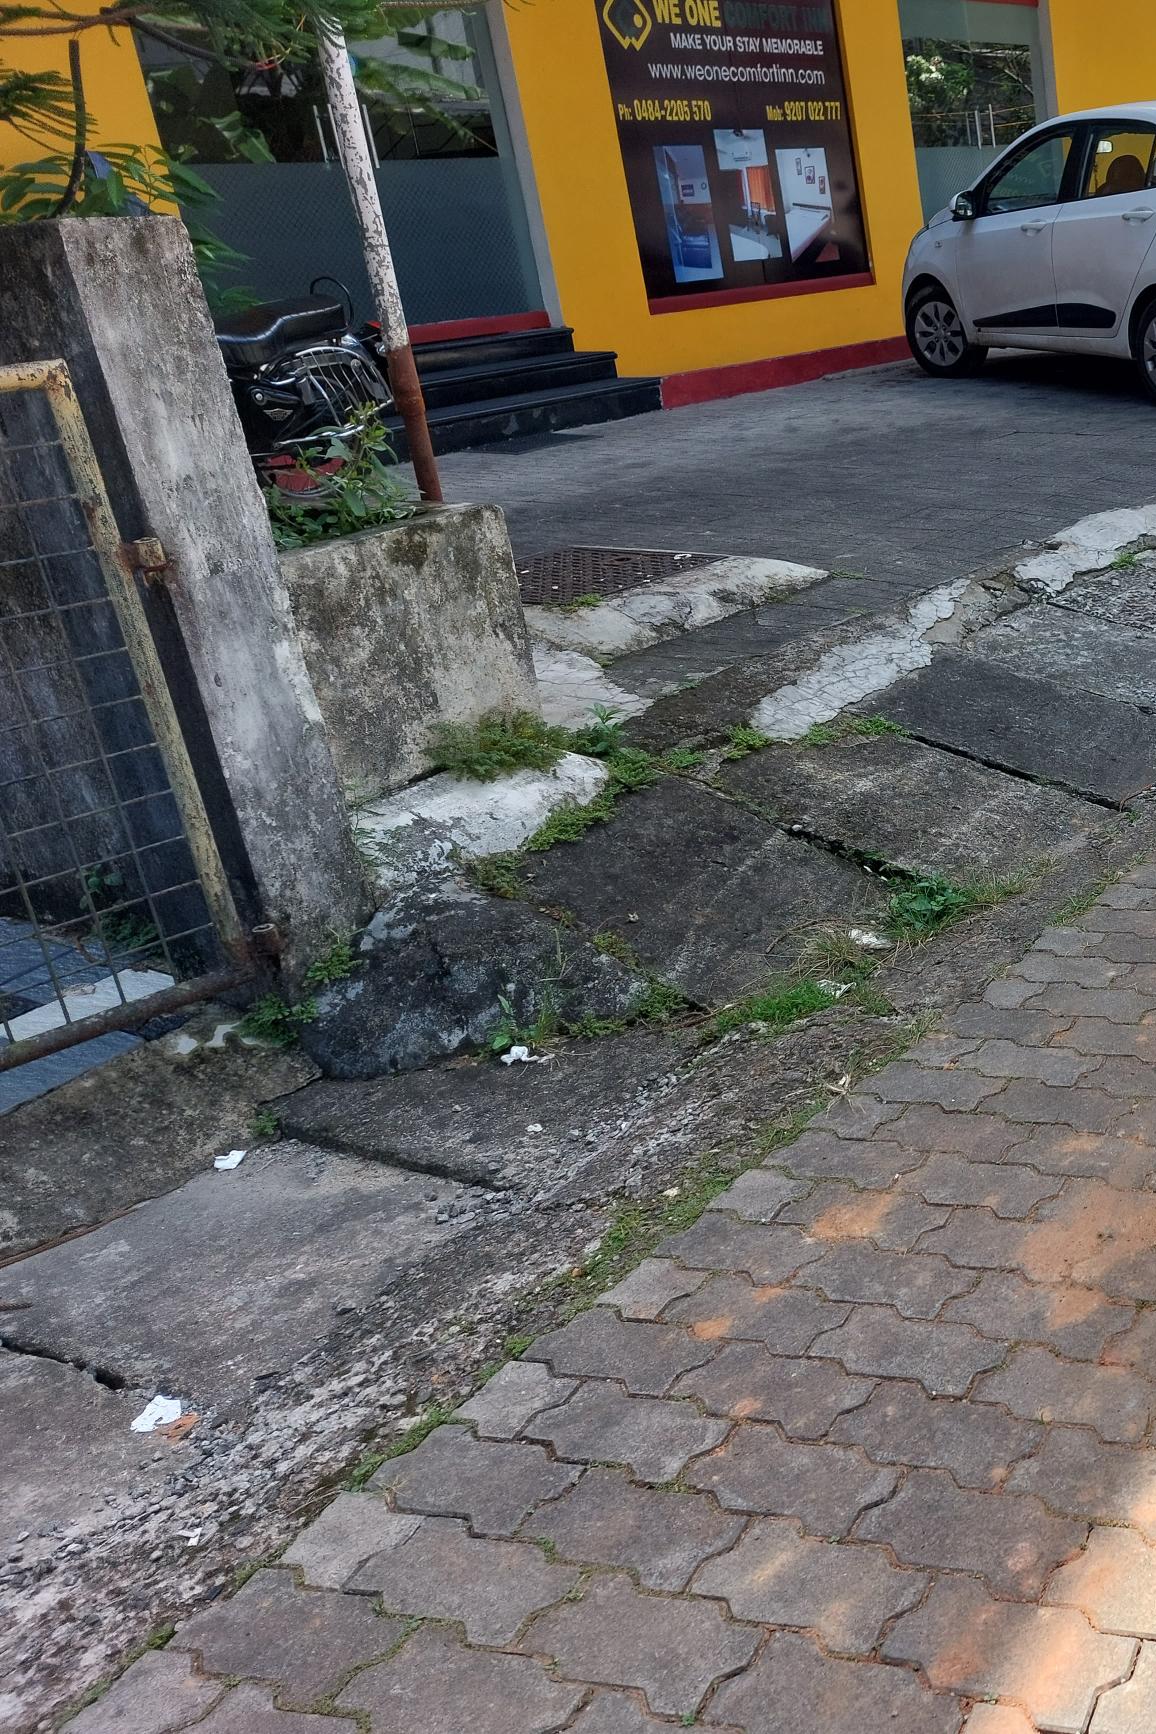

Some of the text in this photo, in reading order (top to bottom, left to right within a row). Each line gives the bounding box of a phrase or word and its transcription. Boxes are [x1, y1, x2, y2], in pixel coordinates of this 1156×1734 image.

[653, 0, 832, 33] WE ONE COMFORT INN
[670, 32, 823, 55] MAKE YOUR STAY MEMORABLE
[648, 63, 825, 85] www.weonecomfortinn.com
[618, 99, 712, 121] Ph: 0484-2205 570
[766, 101, 841, 121] Mob: 9207 022 777
